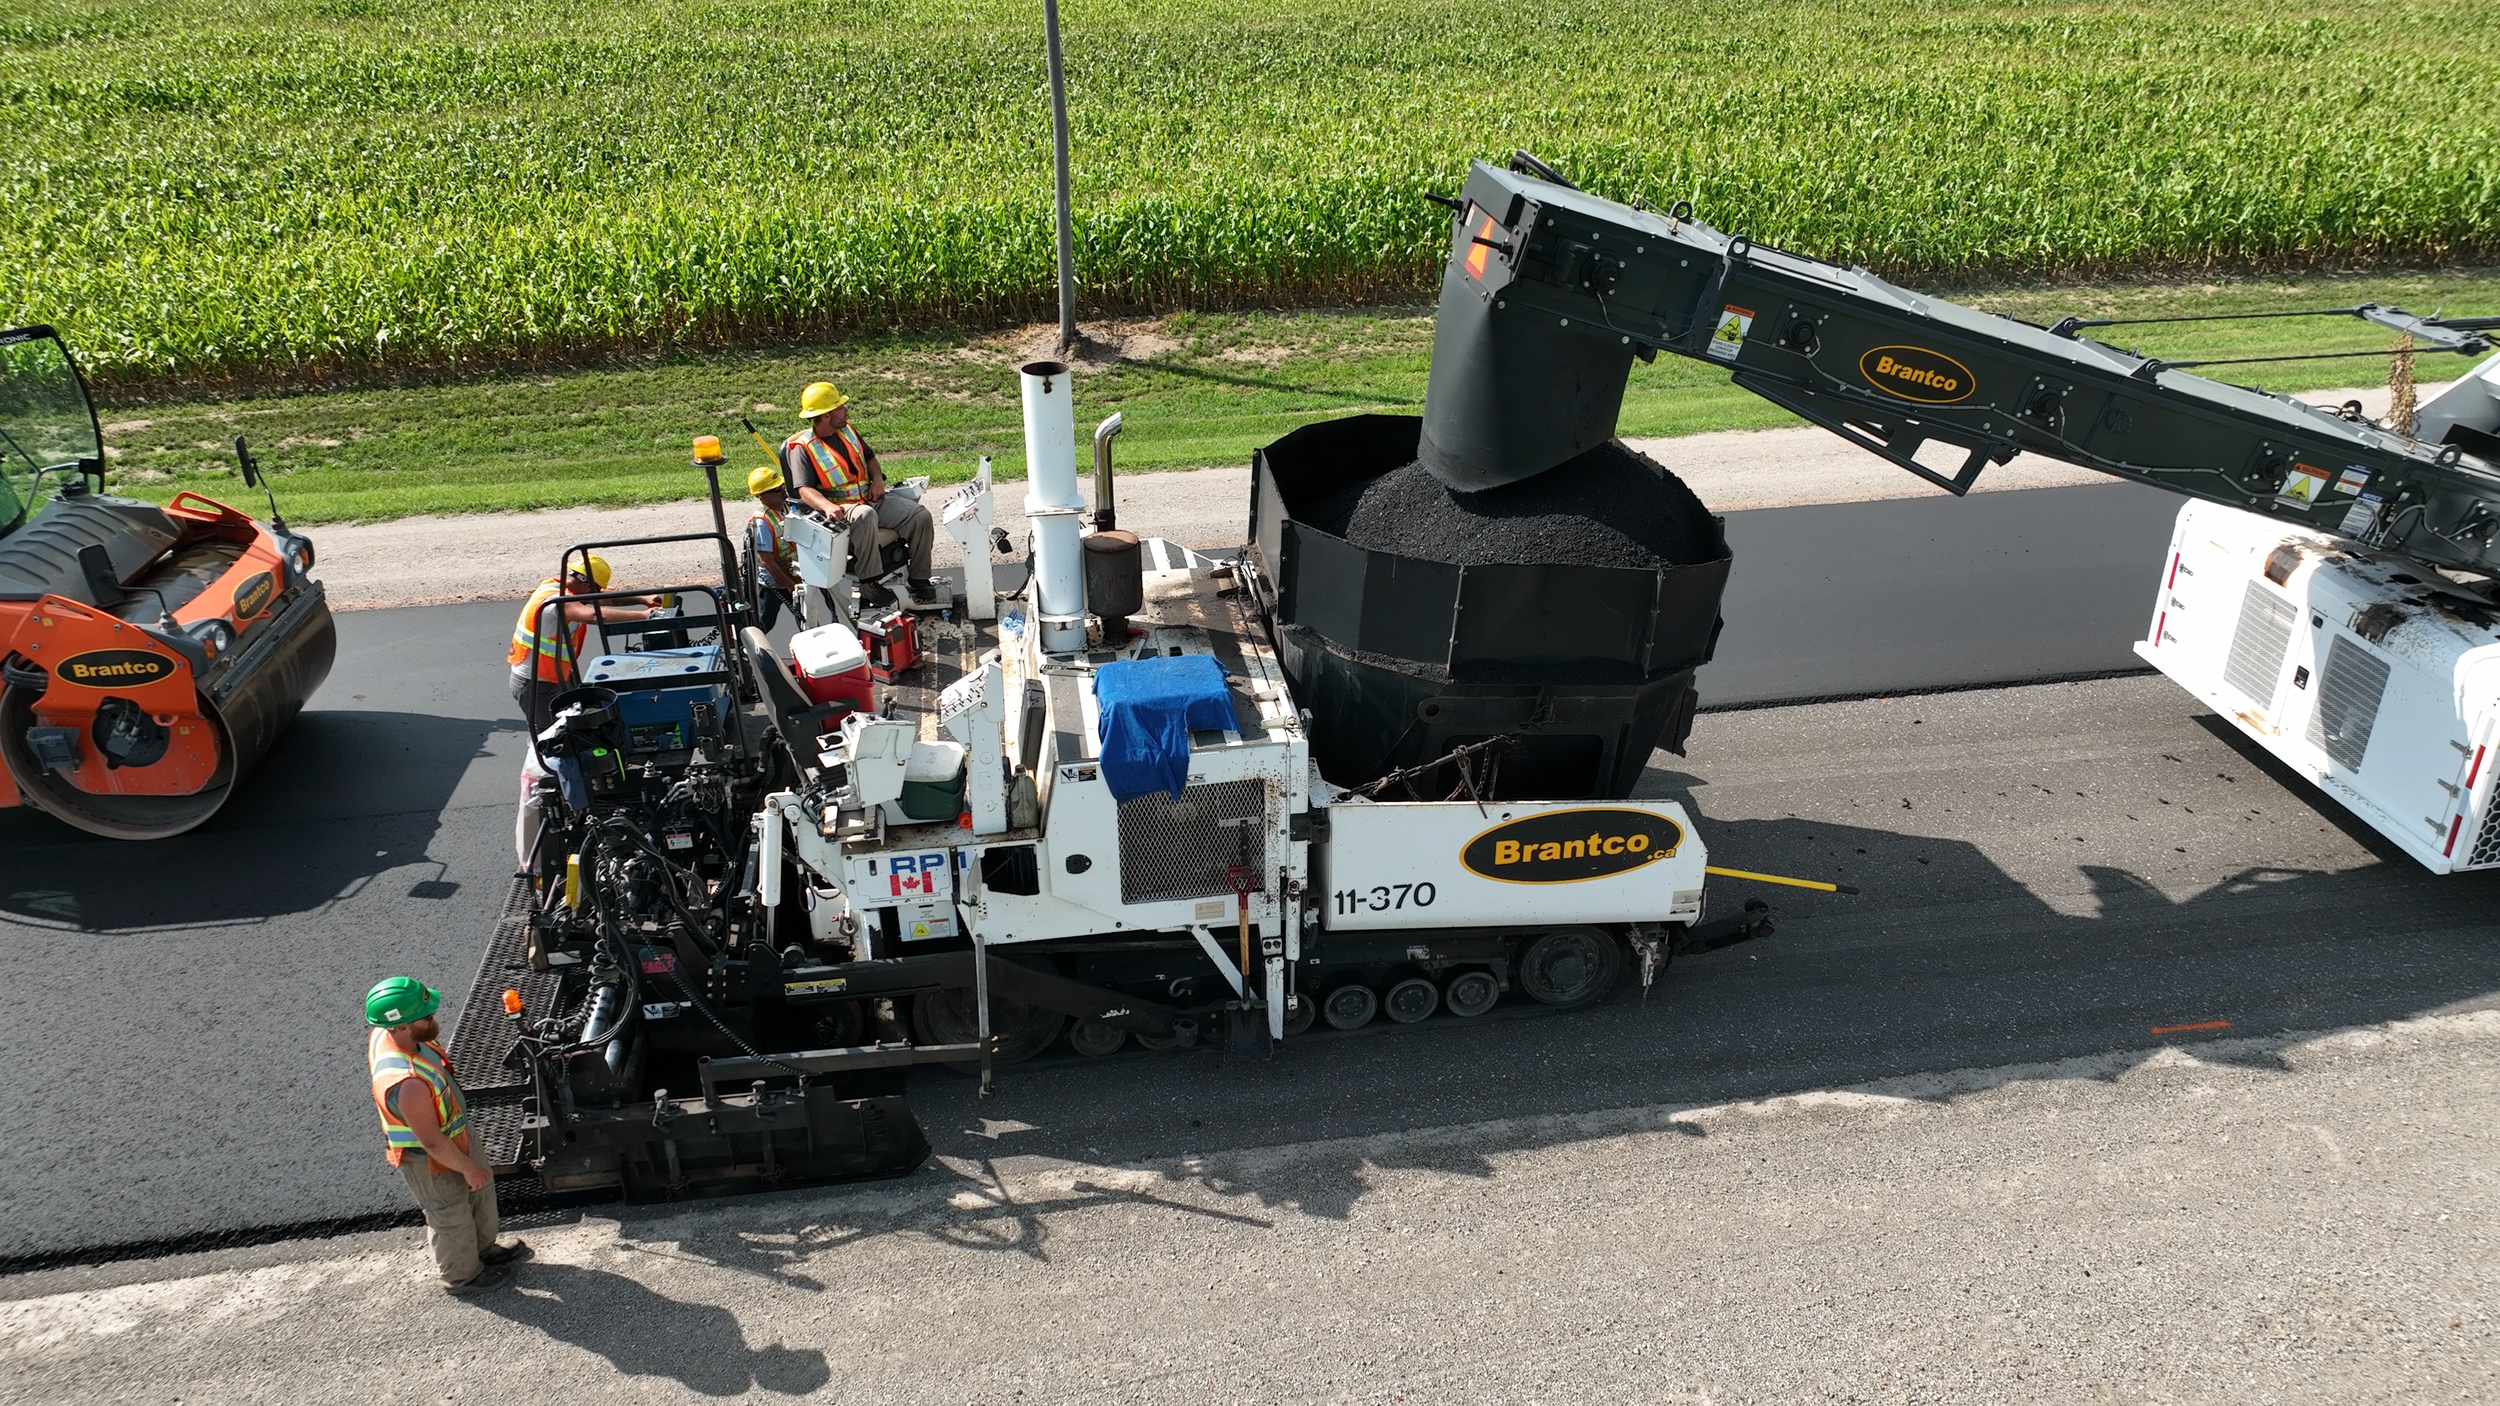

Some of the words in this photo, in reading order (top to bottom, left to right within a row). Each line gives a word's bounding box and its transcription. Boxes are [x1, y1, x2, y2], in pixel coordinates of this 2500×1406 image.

[1875, 355, 1958, 392] Brantco
[2301, 465, 2329, 479] WARNING
[2361, 492, 2384, 503] NOTICE
[239, 580, 270, 613] Brantco
[72, 661, 160, 678] Brantco
[1494, 832, 1650, 866] Brantco
[1334, 881, 1436, 915] 11-370
